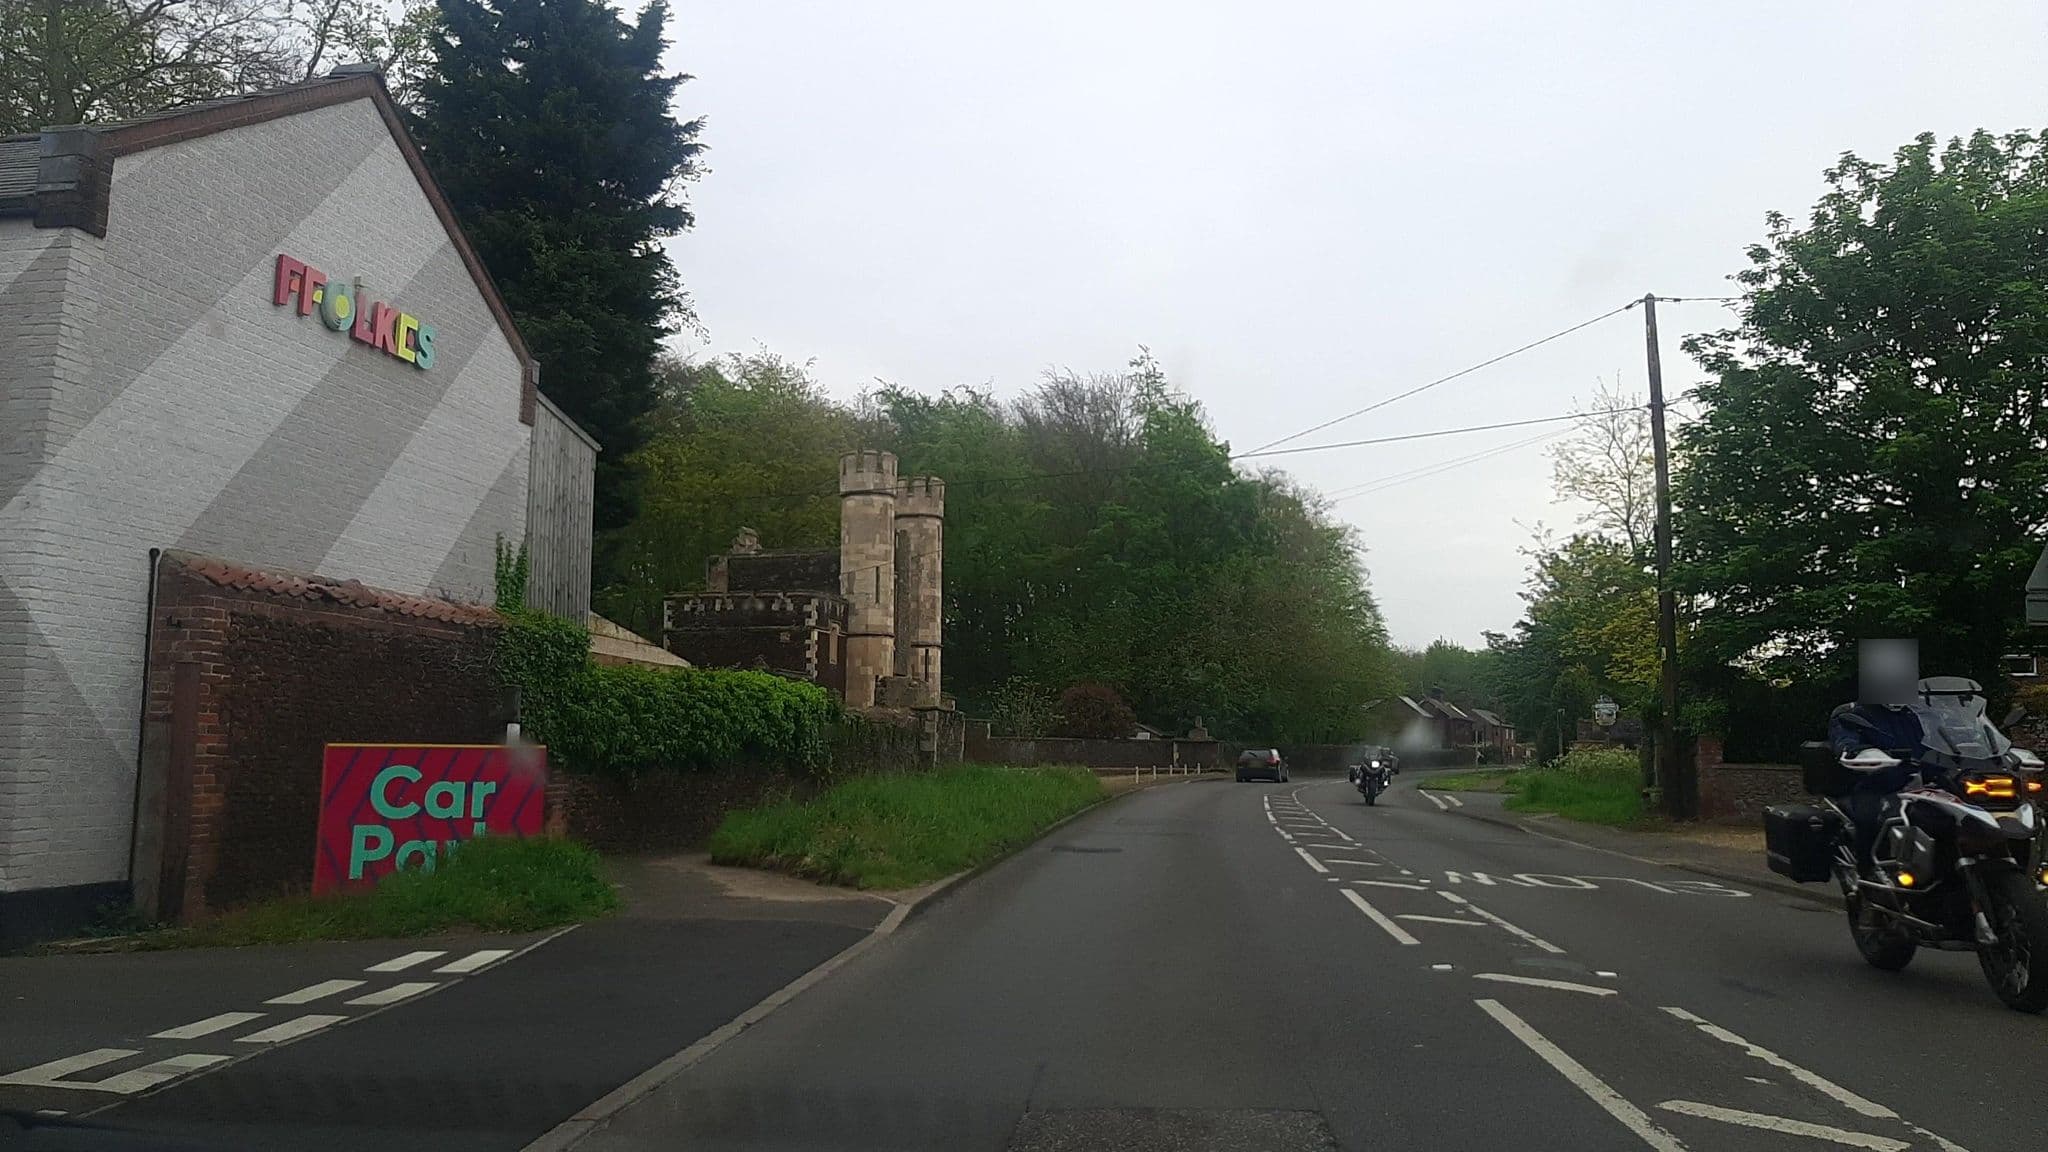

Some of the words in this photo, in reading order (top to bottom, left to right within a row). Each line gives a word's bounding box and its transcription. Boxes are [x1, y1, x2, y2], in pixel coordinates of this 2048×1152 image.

[274, 254, 437, 369] FFOLKES
[370, 764, 496, 819] Car
[348, 821, 487, 879] Pa
[1445, 870, 1751, 897] SLOW
